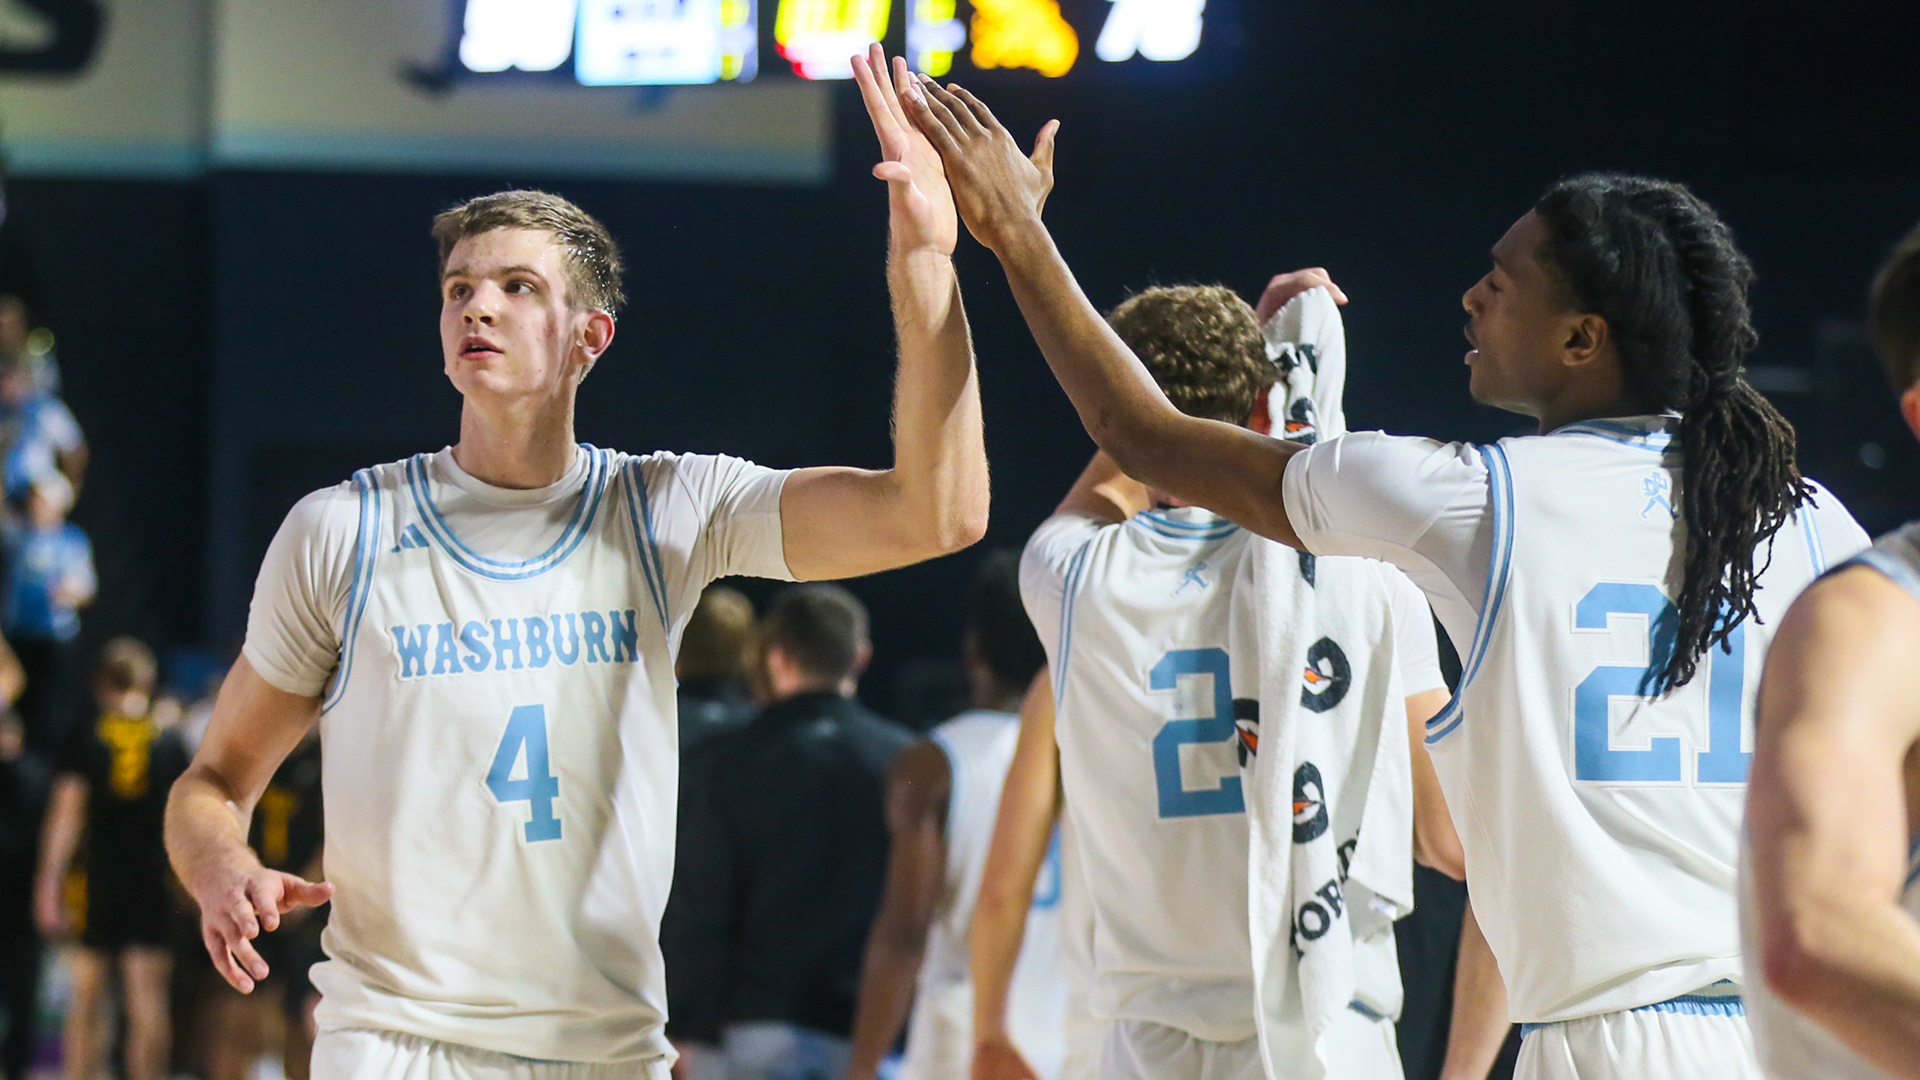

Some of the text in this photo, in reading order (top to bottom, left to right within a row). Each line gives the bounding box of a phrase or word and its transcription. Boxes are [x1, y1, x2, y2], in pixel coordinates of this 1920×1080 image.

[390, 608, 640, 679] WASHBURN
[1574, 580, 1756, 785] 21
[485, 703, 563, 844] 4
[1149, 646, 1247, 820] 2
